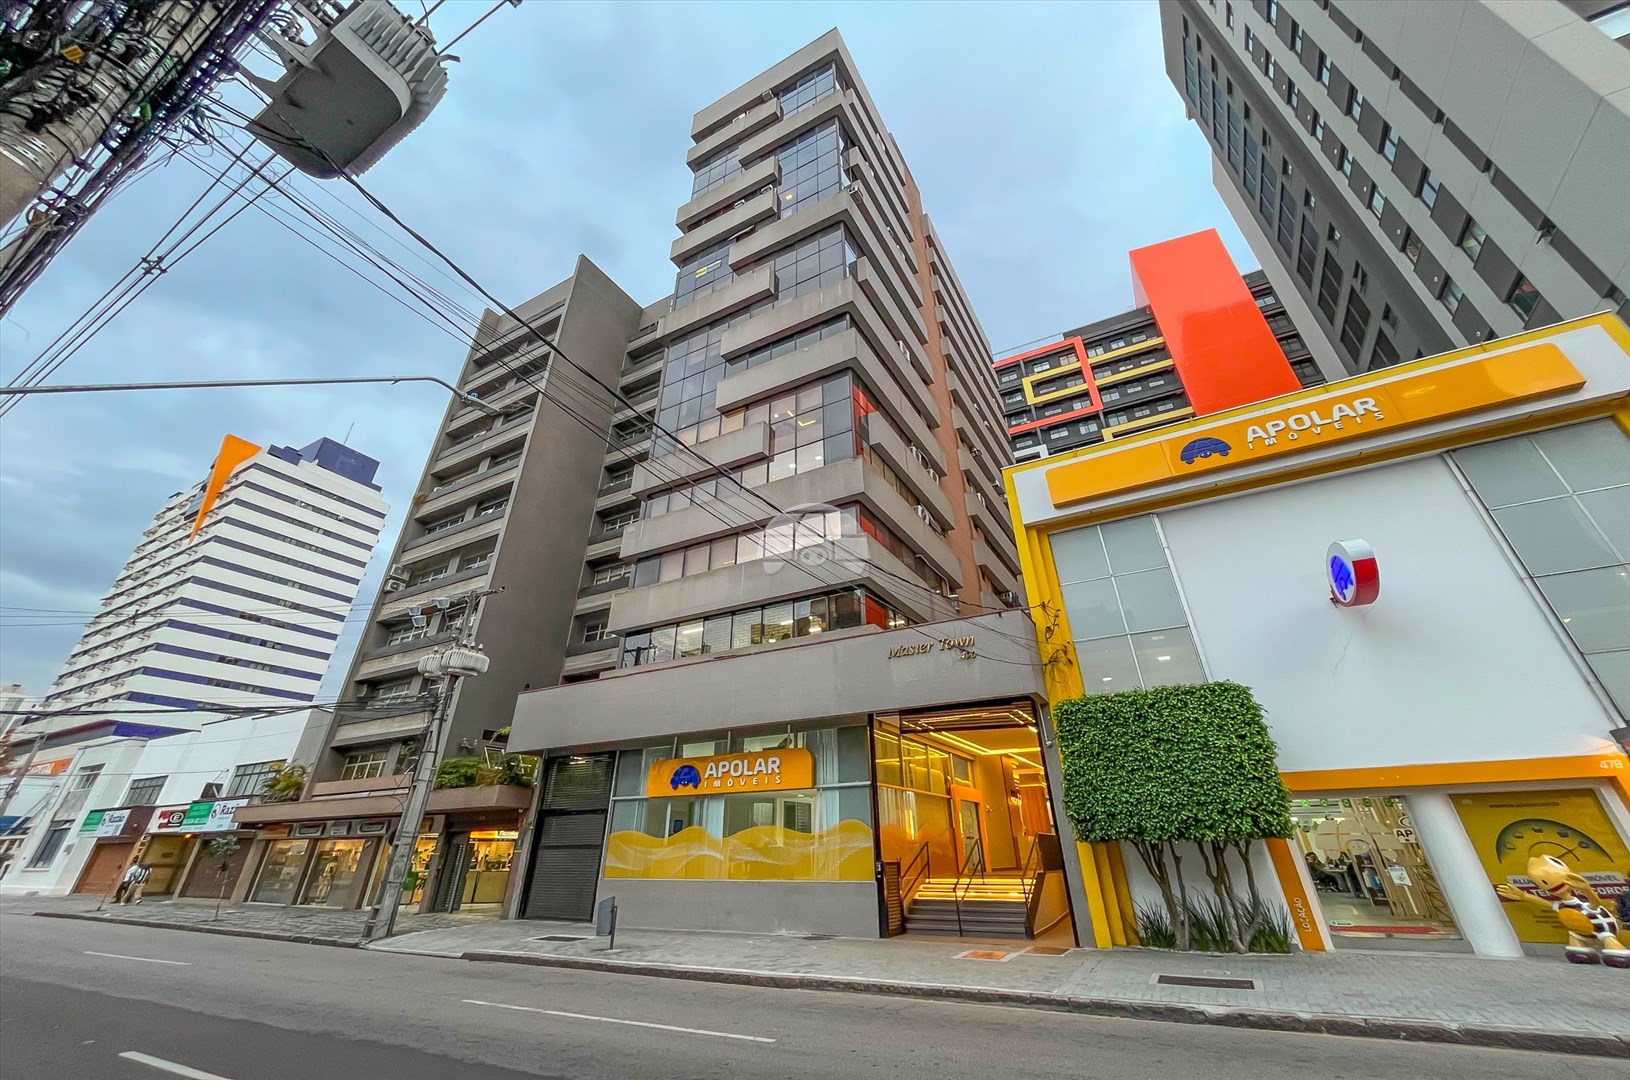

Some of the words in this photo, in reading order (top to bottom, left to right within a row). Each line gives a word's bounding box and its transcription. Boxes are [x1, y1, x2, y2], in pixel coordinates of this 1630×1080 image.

[1247, 397, 1380, 443] APOLAR
[1248, 411, 1385, 450] IMÓVEIS
[887, 642, 935, 659] Master
[938, 635, 975, 651] Town
[704, 756, 781, 779] APOLAR
[704, 775, 781, 788] IMÓVEIS
[1293, 897, 1312, 933] LOCAÇÃO
